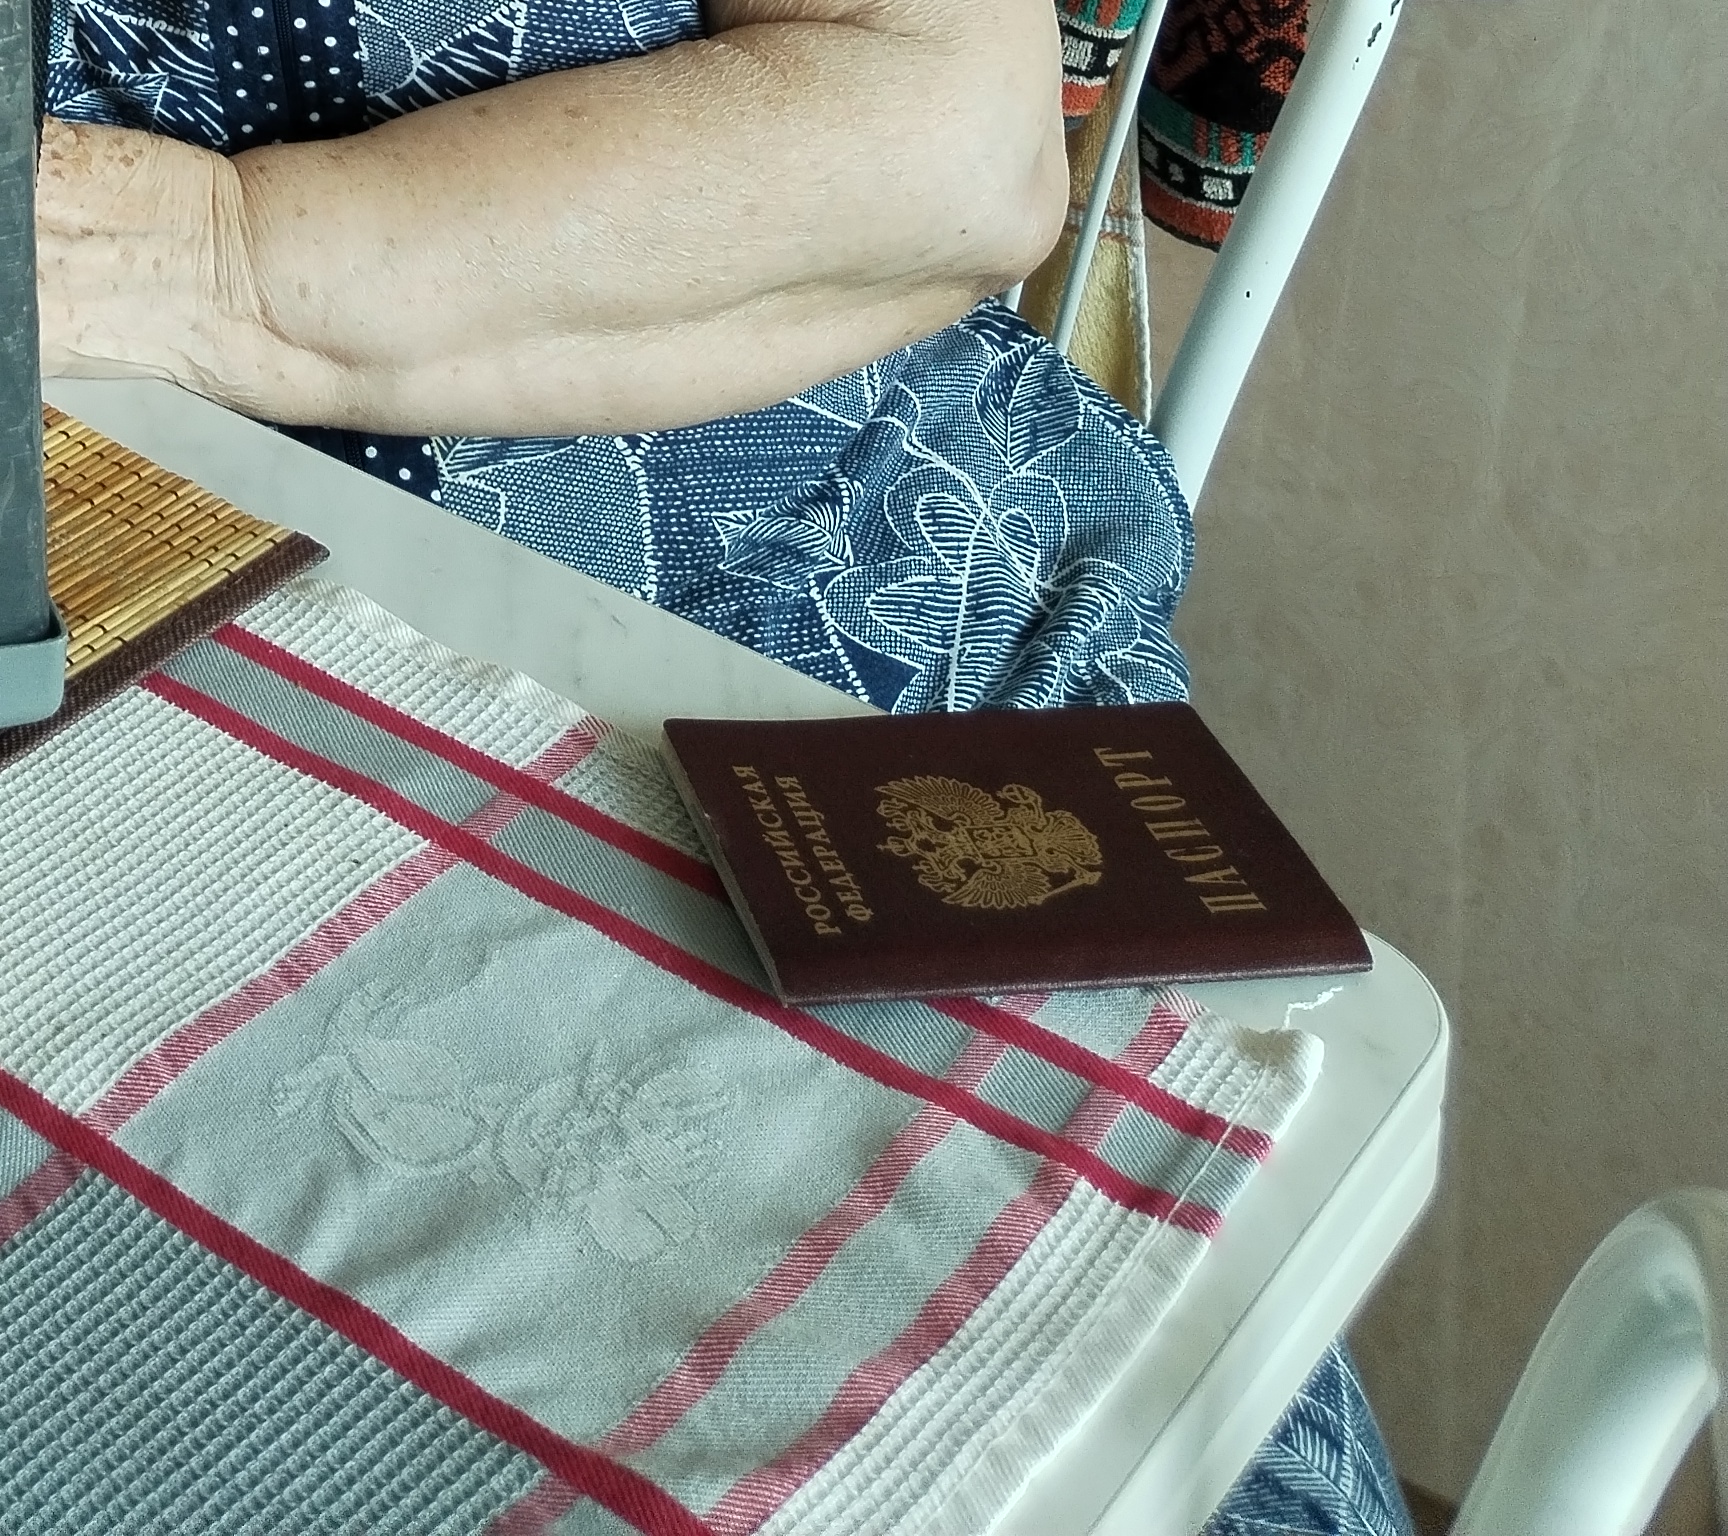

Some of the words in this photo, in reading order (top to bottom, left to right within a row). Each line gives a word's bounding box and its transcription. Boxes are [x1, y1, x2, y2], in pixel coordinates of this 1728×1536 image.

[732, 765, 843, 935] РОССИЙСКАЯ
[774, 776, 874, 922] ФЕДЕРАЦИЯ
[1093, 748, 1267, 914] ПАСПОРТ
